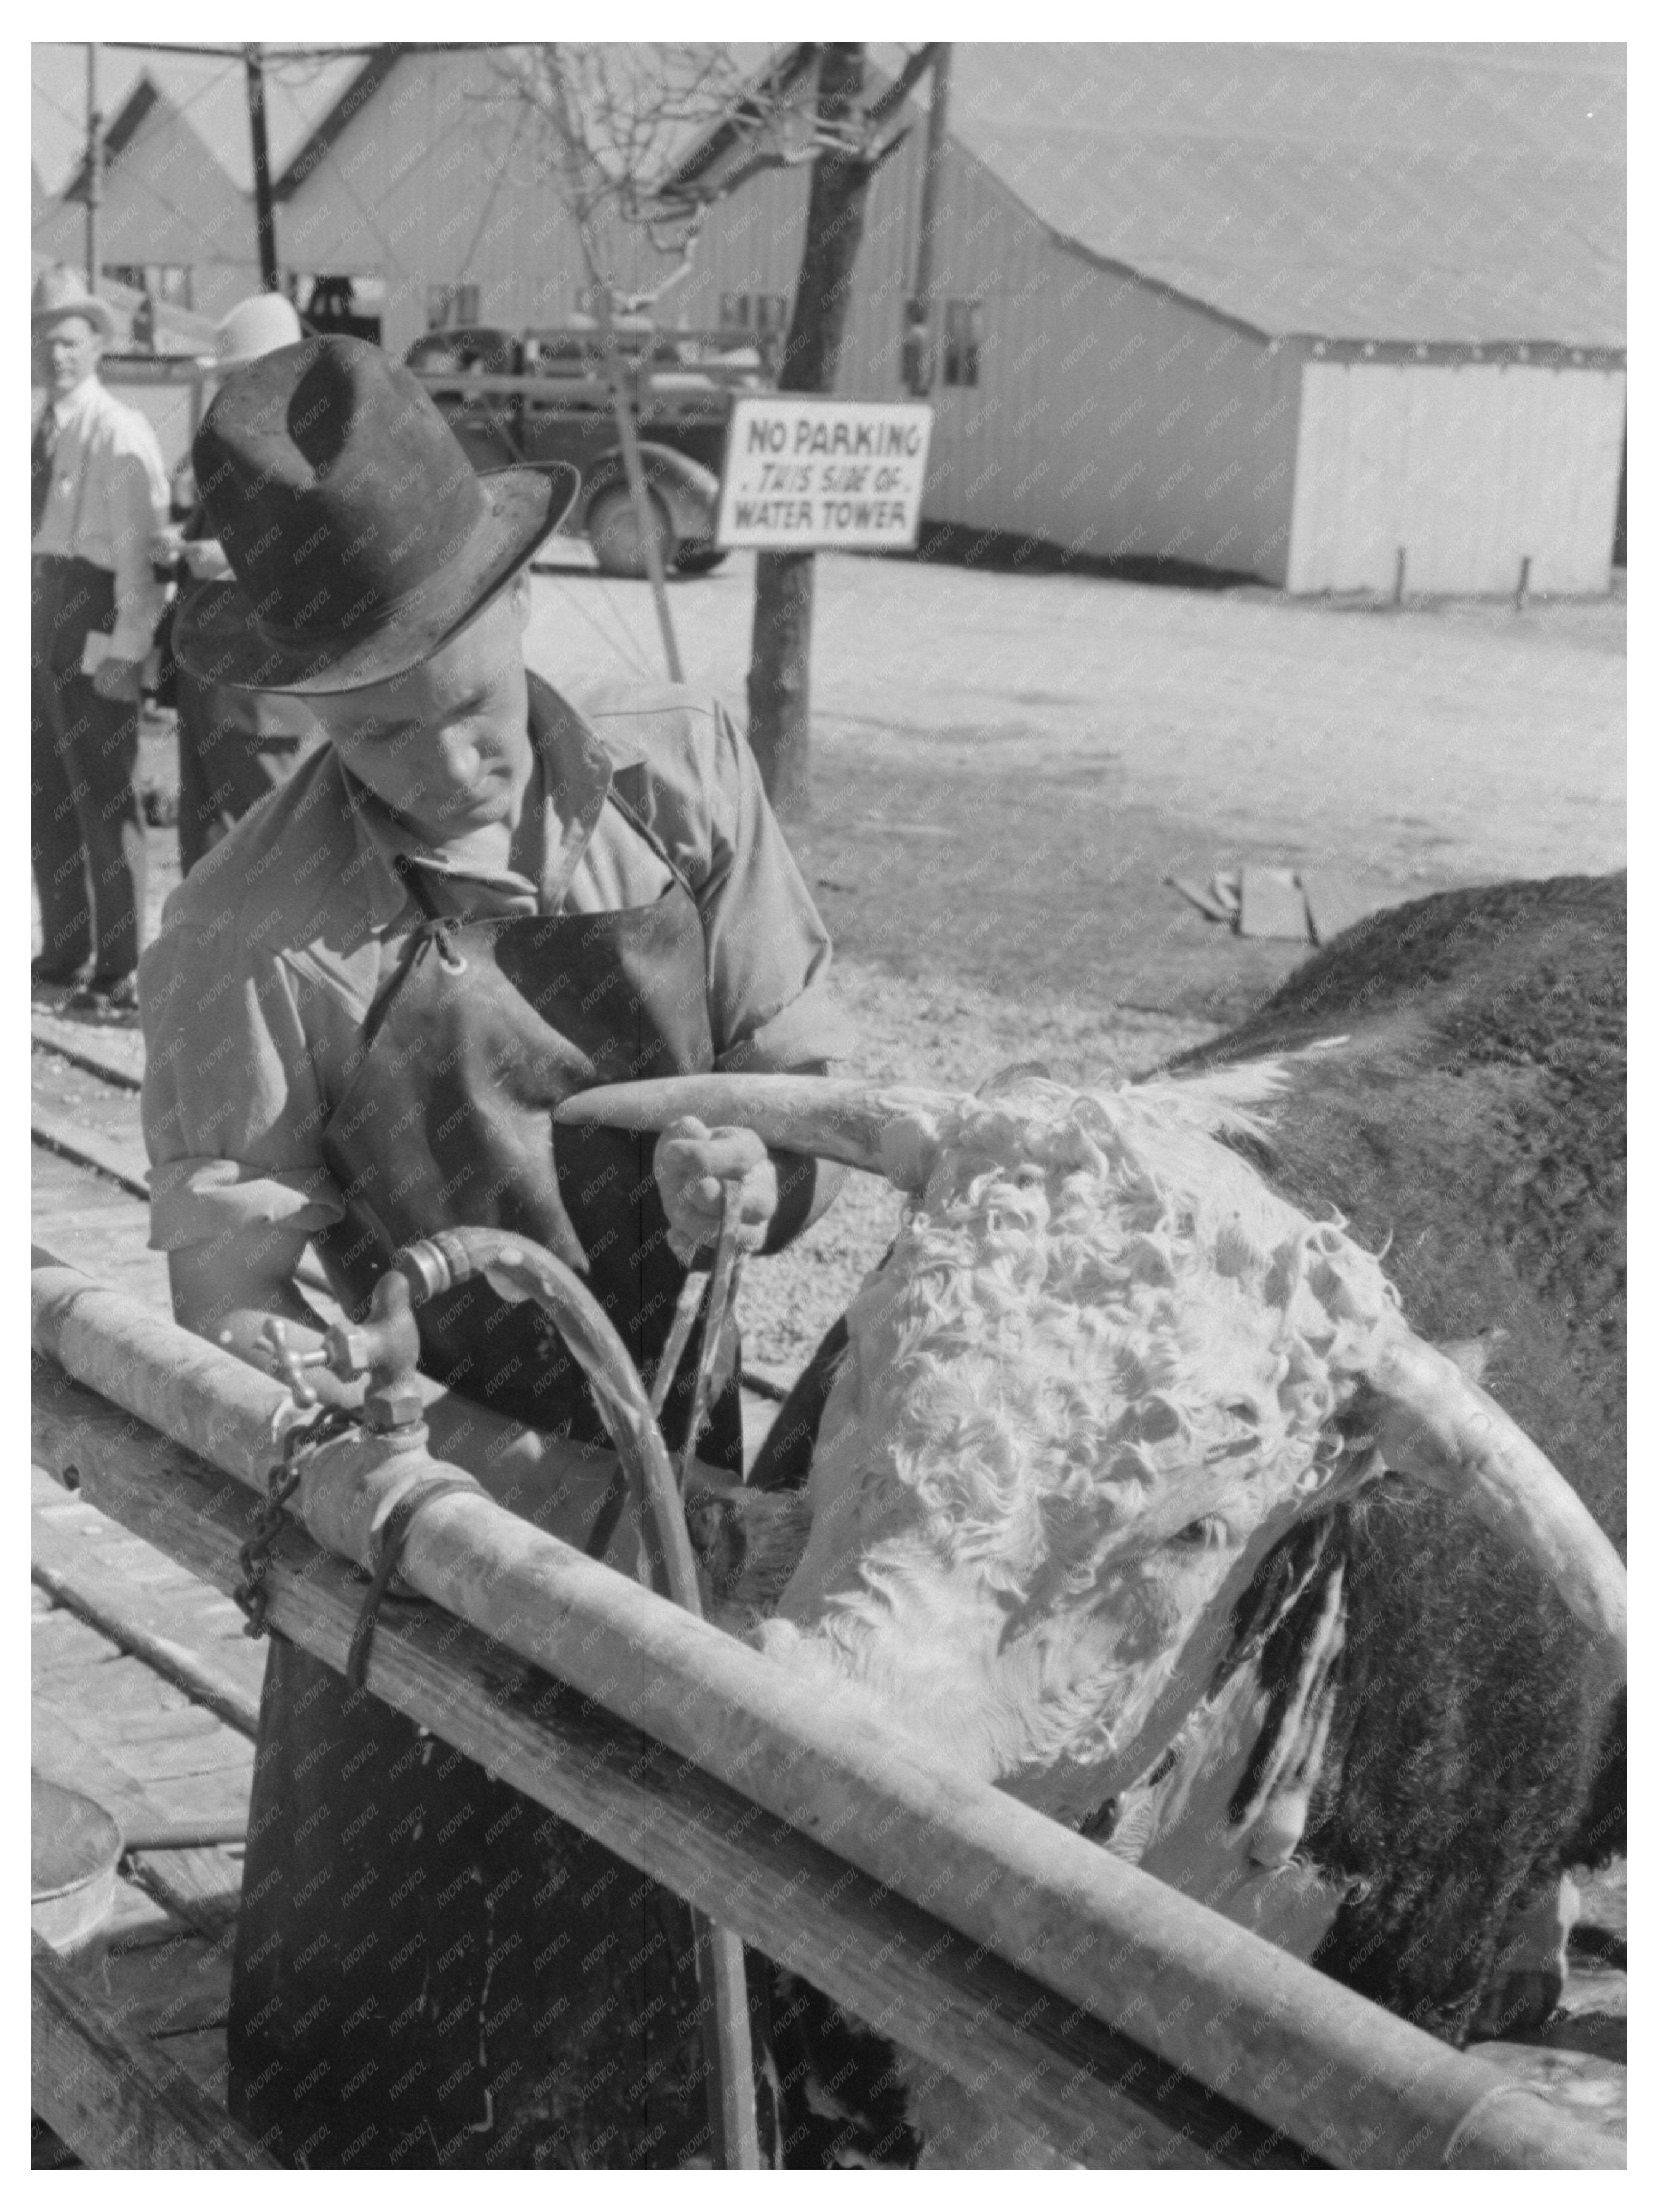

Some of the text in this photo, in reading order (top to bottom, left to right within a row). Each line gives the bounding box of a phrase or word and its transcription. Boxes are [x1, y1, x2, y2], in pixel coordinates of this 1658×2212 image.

[747, 420, 922, 457] NO PARKING
[735, 500, 906, 529] WATER TOWER
